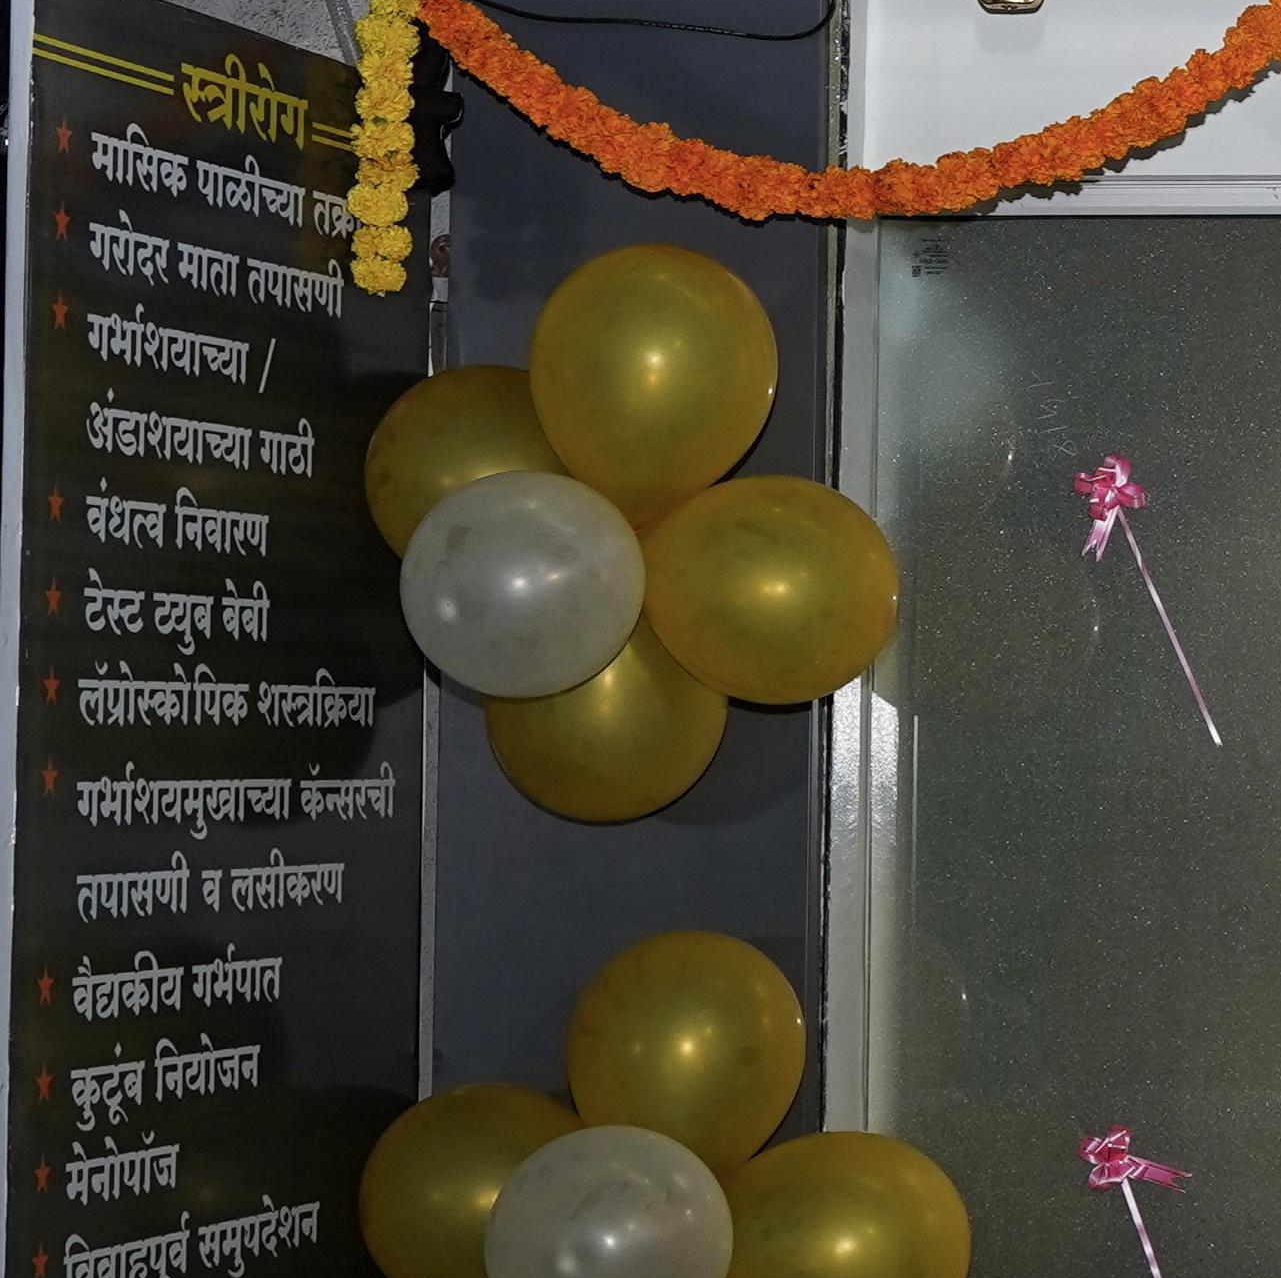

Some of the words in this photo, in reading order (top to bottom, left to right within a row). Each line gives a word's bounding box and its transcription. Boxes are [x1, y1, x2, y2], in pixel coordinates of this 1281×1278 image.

[181, 54, 309, 147] स्त्रीरोग
[92, 123, 188, 197] मासिक
[197, 155, 305, 227] पाळीच्या
[89, 210, 169, 285] गरोदर
[178, 242, 239, 296] माता
[247, 258, 344, 318] तपासणी
[87, 304, 249, 384] गर्भाशयाच्या
[86, 388, 252, 470] अंडाशयाच्या
[260, 418, 314, 477] गाठी
[175, 487, 269, 556] निवारण
[84, 568, 145, 635] टेस्ट
[222, 579, 270, 641] बेबी
[258, 668, 375, 727] शस्त्रक्रिया
[77, 761, 291, 839] गर्भाशयमुखाच्या
[300, 762, 395, 820] कॅन्सरची
[77, 851, 190, 922] तपासणी
[202, 870, 222, 912] व
[231, 848, 344, 911] लसीकरण
[72, 951, 184, 1021] वैद्यकीय
[192, 943, 282, 1006] गर्भपात
[154, 1033, 260, 1101] नियोजन
[66, 1131, 179, 1205] मेनोपॉज
[198, 1195, 320, 1278] समुपदेशन
